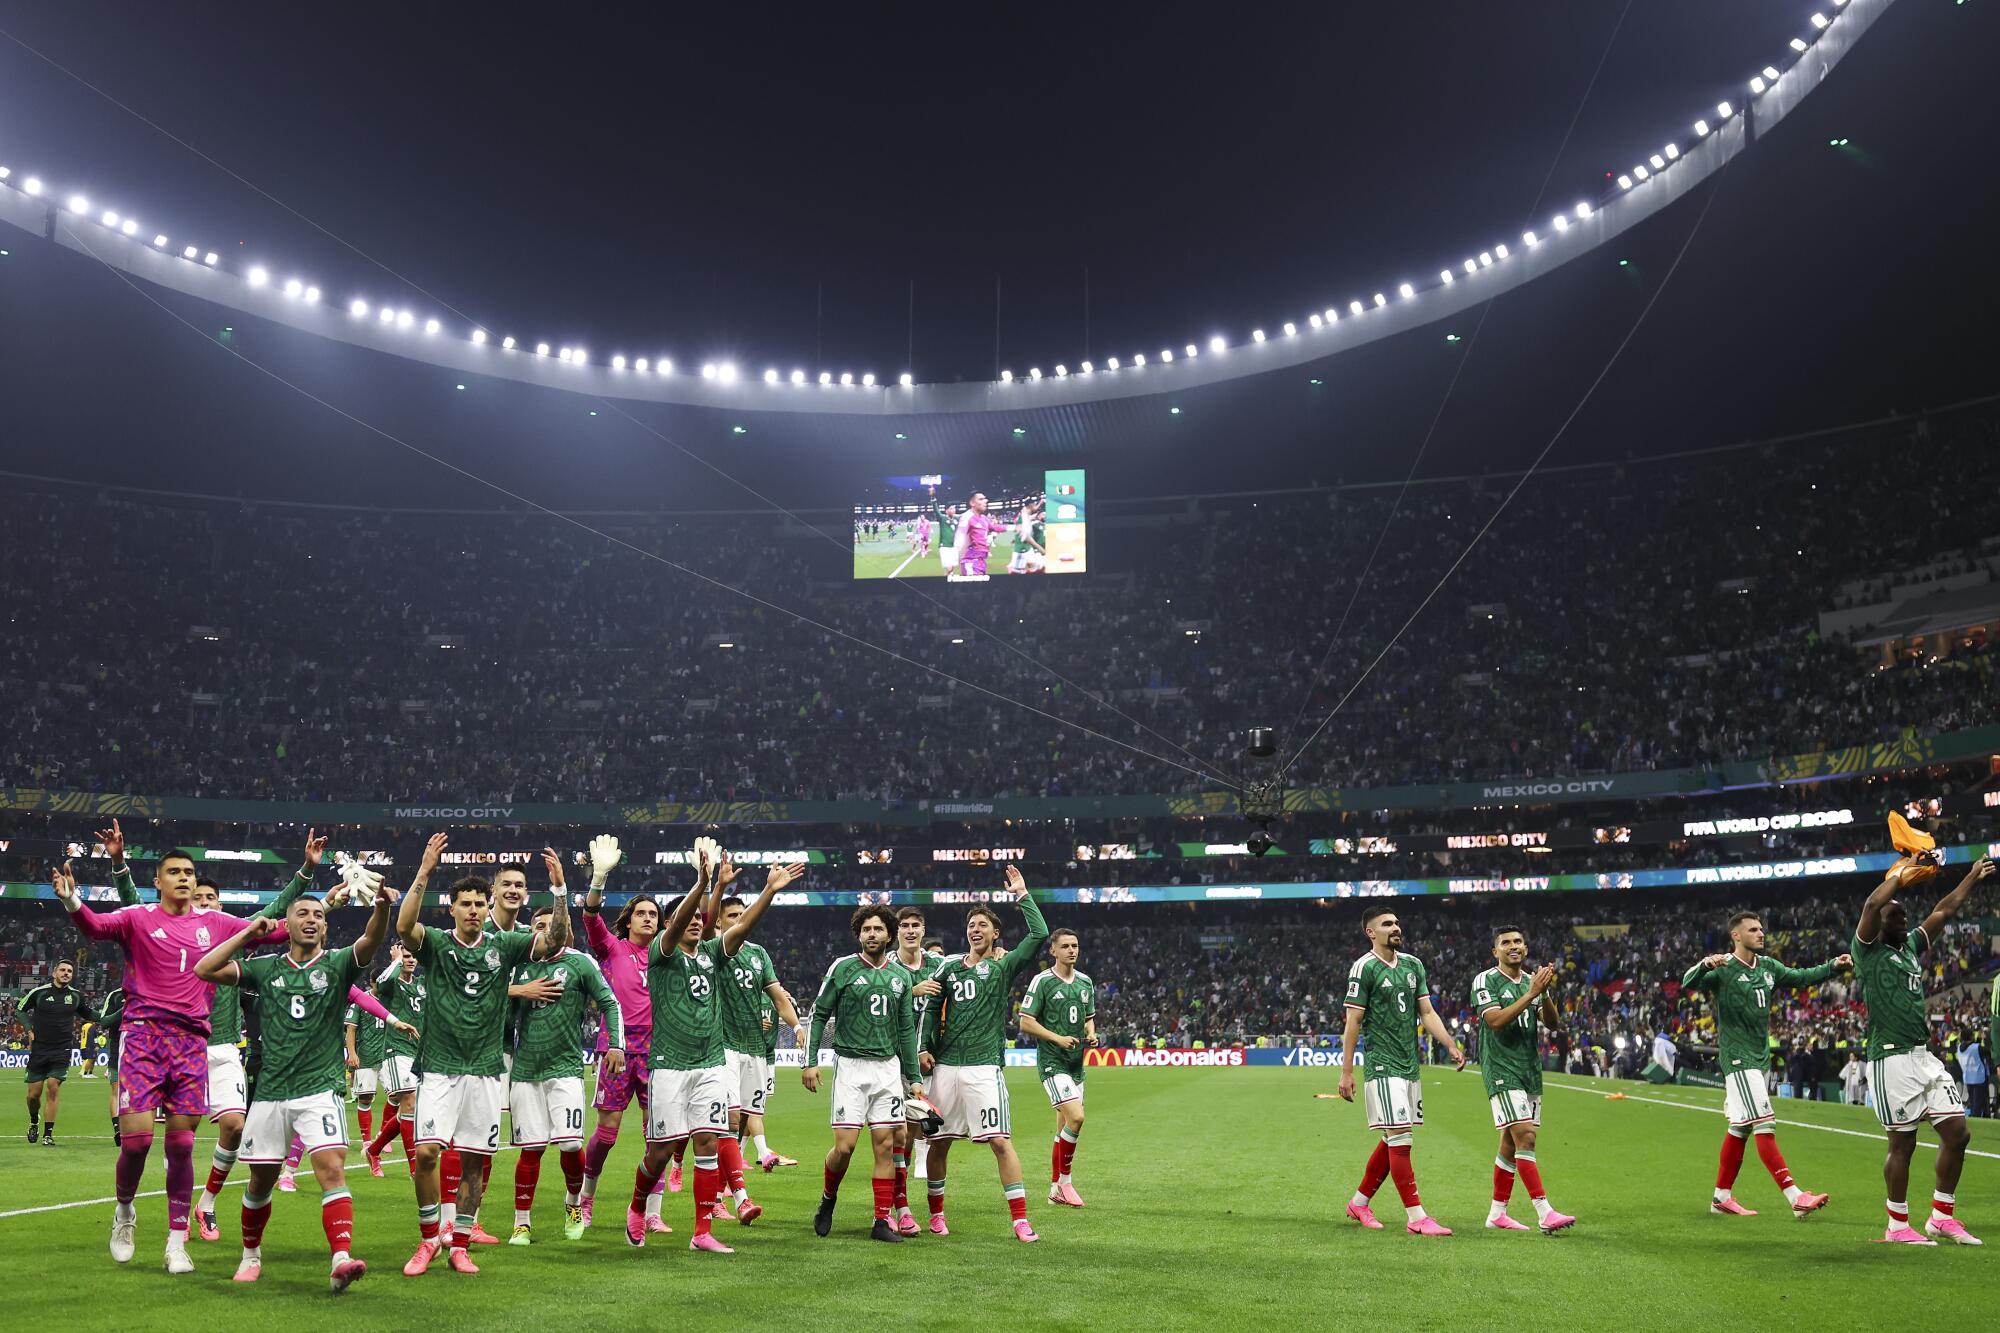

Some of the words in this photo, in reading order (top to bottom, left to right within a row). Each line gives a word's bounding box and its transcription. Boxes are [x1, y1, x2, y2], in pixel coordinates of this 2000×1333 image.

[1484, 784, 1562, 797] MEXICO
[1567, 780, 1613, 793] CITY
[395, 808, 466, 818] MEXICO
[471, 807, 513, 818] CITY
[1684, 821, 1716, 836] FIFA
[1716, 817, 1769, 833] WORLD
[1770, 814, 1800, 829] CUP
[1447, 836, 1508, 848] MEXICO
[1511, 833, 1547, 846] CITY
[441, 852, 496, 864] MEXICO
[499, 852, 532, 864] CITY
[655, 852, 683, 864] FIFA
[734, 851, 761, 864] CUP
[933, 849, 989, 861] MEXICO
[992, 848, 1025, 860] CITY
[1687, 868, 1720, 883] FIFA
[1719, 864, 1773, 881] WORLD
[1774, 862, 1804, 878] CUP
[1449, 877, 1510, 892] MEXICO
[1513, 877, 1549, 891] CITY
[933, 891, 989, 903] MEXICO
[992, 890, 1018, 902] CIT
[180, 949, 187, 973] 1
[465, 971, 480, 995] 2
[689, 975, 710, 997] 23
[734, 968, 753, 989] 22
[953, 979, 976, 1002] 20
[1755, 988, 1766, 1008] 11
[290, 994, 305, 1019] 6
[409, 997, 422, 1012] 15
[870, 994, 888, 1016] 21
[1397, 992, 1406, 1013] 5
[1069, 1006, 1078, 1024] 8
[0, 1050, 29, 1068] Rexo
[1124, 1049, 1243, 1066] McDonald's
[1298, 1047, 1364, 1066] Rexon
[565, 1108, 583, 1129] 10
[709, 1102, 727, 1124] 23
[980, 1107, 998, 1129] 20
[322, 1113, 337, 1137] 6
[487, 1124, 499, 1147] 2
